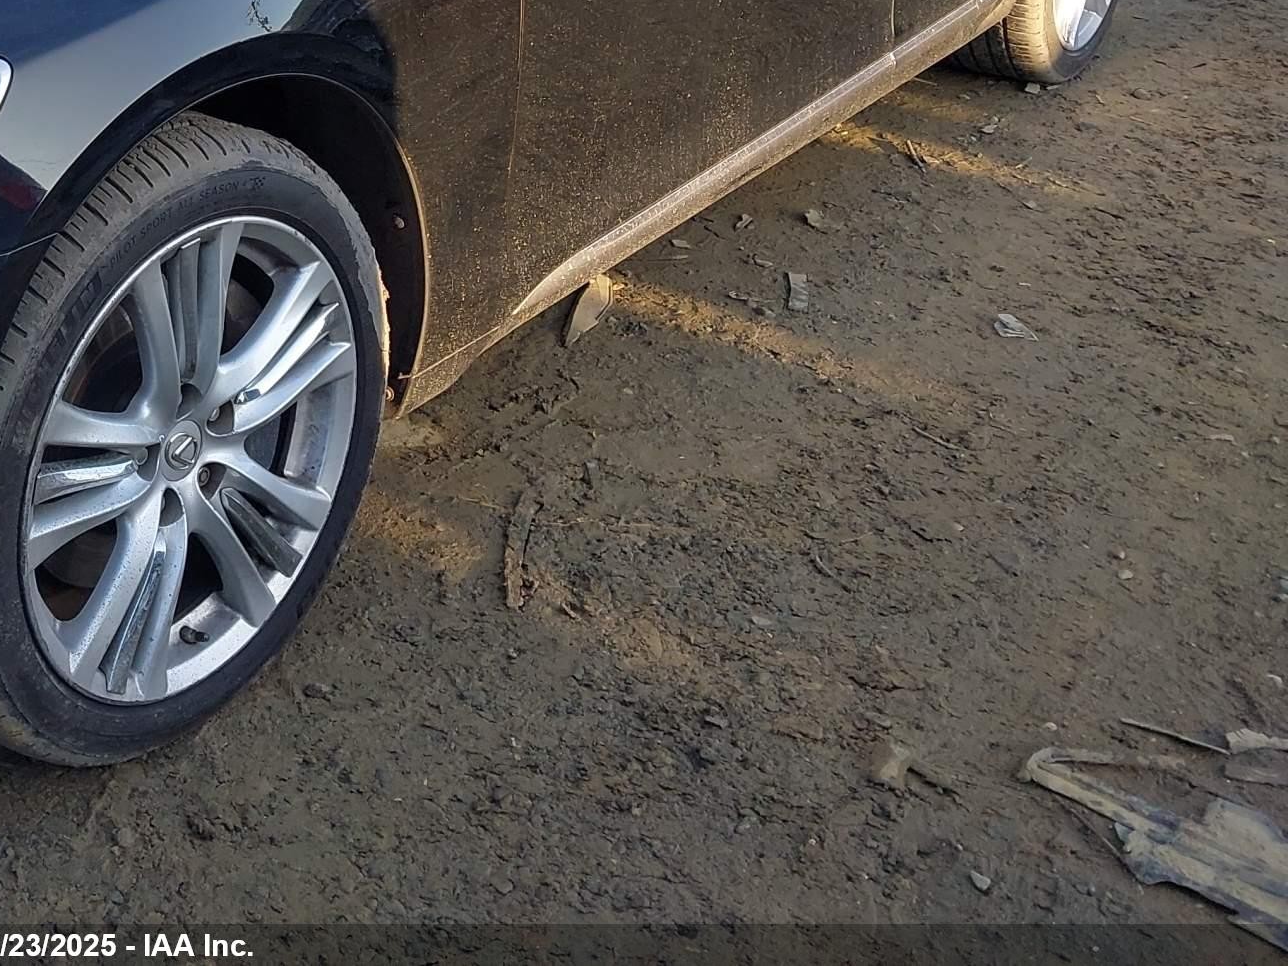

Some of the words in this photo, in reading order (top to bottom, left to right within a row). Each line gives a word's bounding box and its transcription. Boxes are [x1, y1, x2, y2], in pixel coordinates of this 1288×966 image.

[109, 235, 137, 265] PILOT
[140, 207, 172, 237] SPORT
[178, 197, 193, 211] ALL
[199, 181, 240, 200] SEASON
